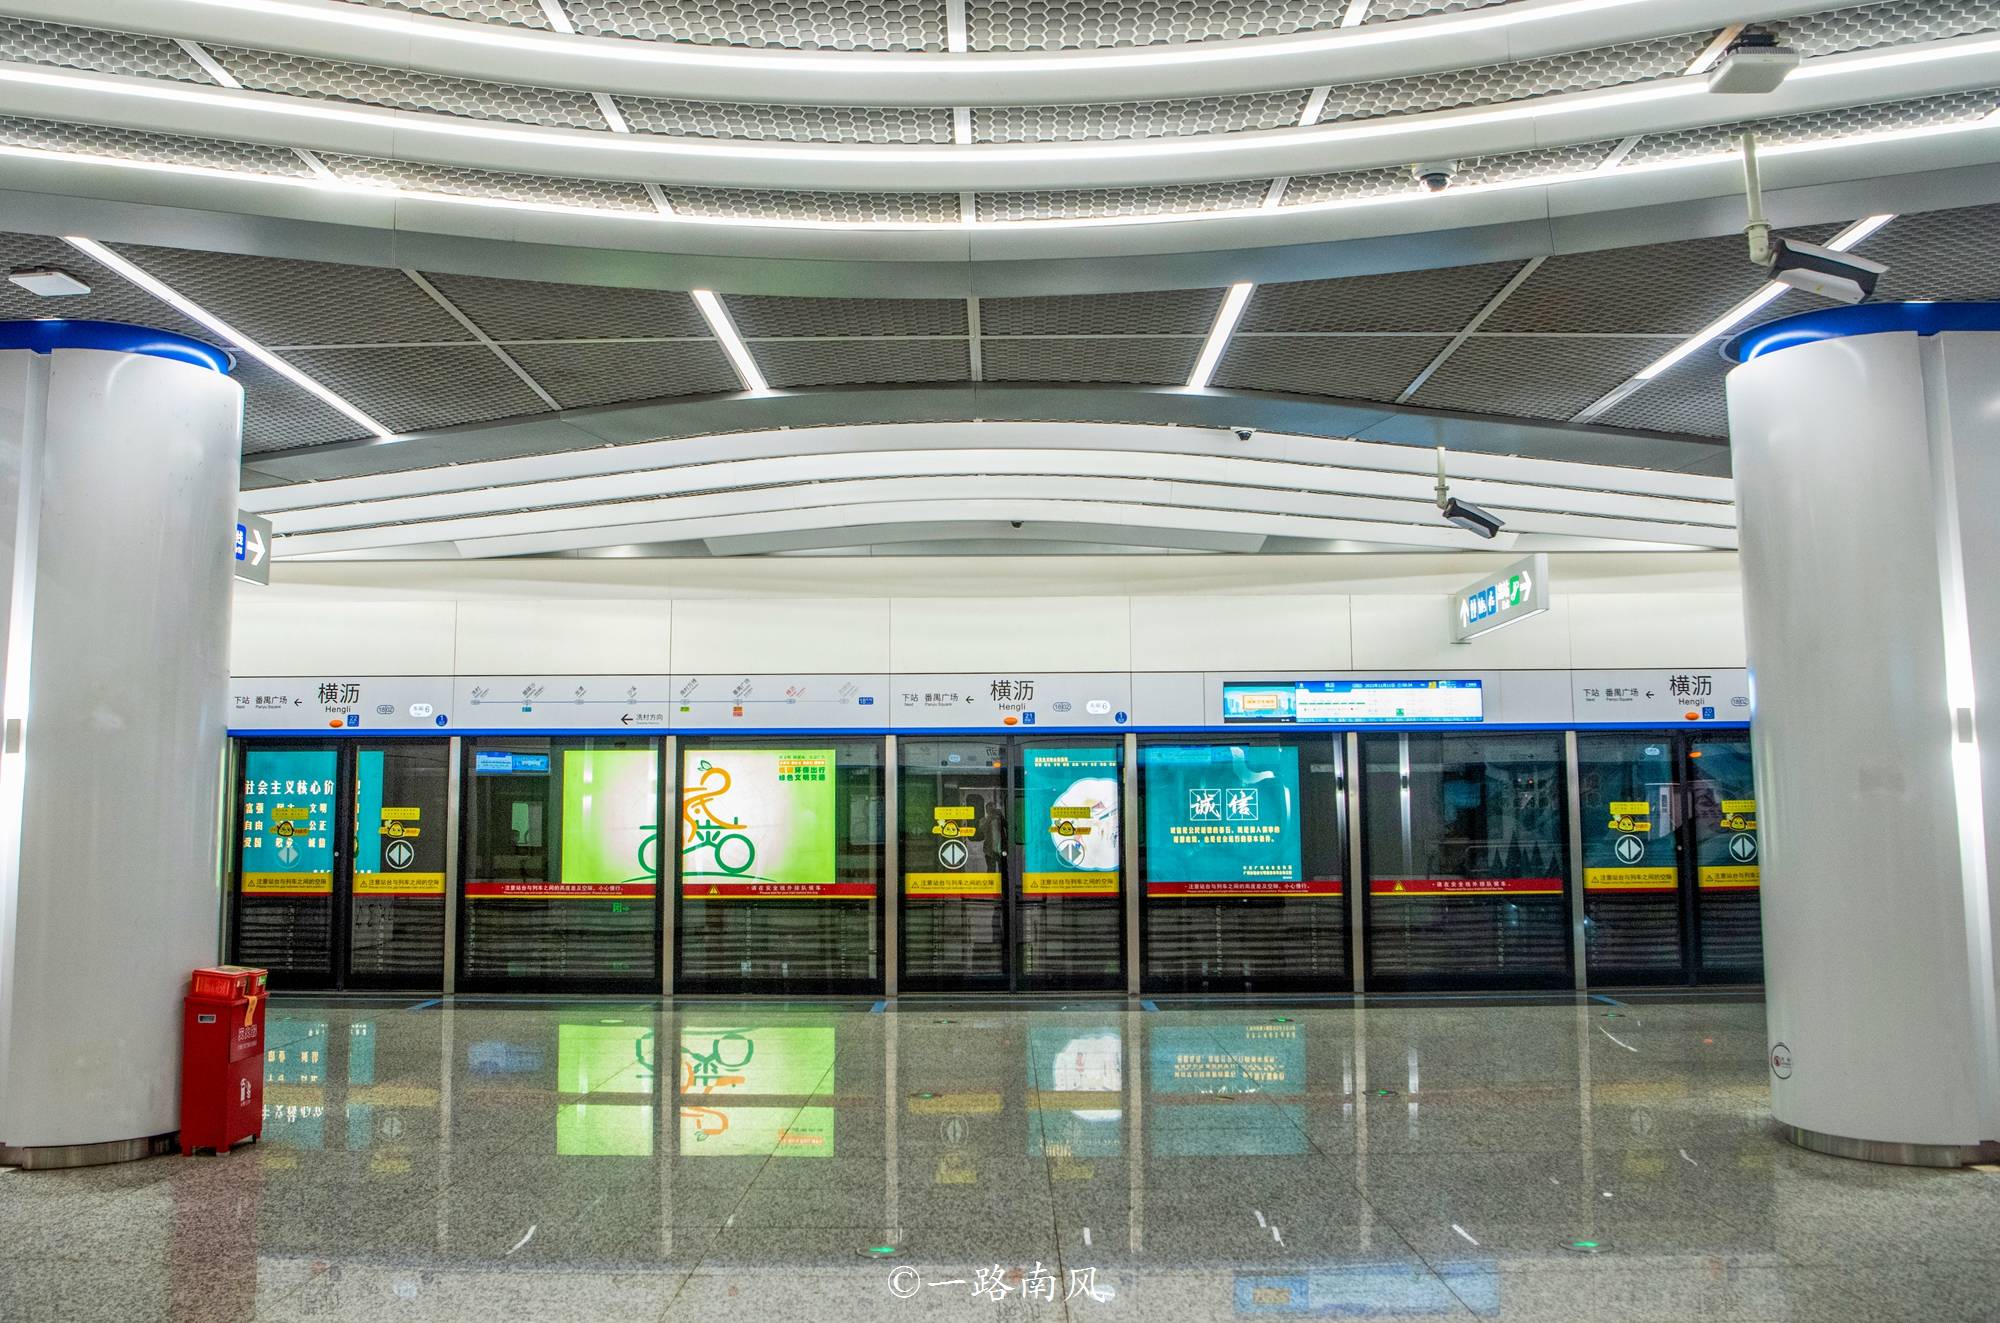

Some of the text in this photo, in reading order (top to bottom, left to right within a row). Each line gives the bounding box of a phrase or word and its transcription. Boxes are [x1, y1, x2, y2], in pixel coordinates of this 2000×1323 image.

[990, 679, 1034, 702] 横沥
[1669, 675, 1712, 697] 横沥
[317, 682, 361, 704] 横沥
[901, 692, 919, 702] 下站
[1583, 688, 1600, 698] 下站
[234, 695, 250, 705] 下站
[1678, 698, 1706, 707] Hengli
[325, 705, 351, 715] Hengli
[998, 703, 1026, 713] Hengli
[1190, 790, 1254, 818] 诚信
[308, 820, 328, 831] 公正
